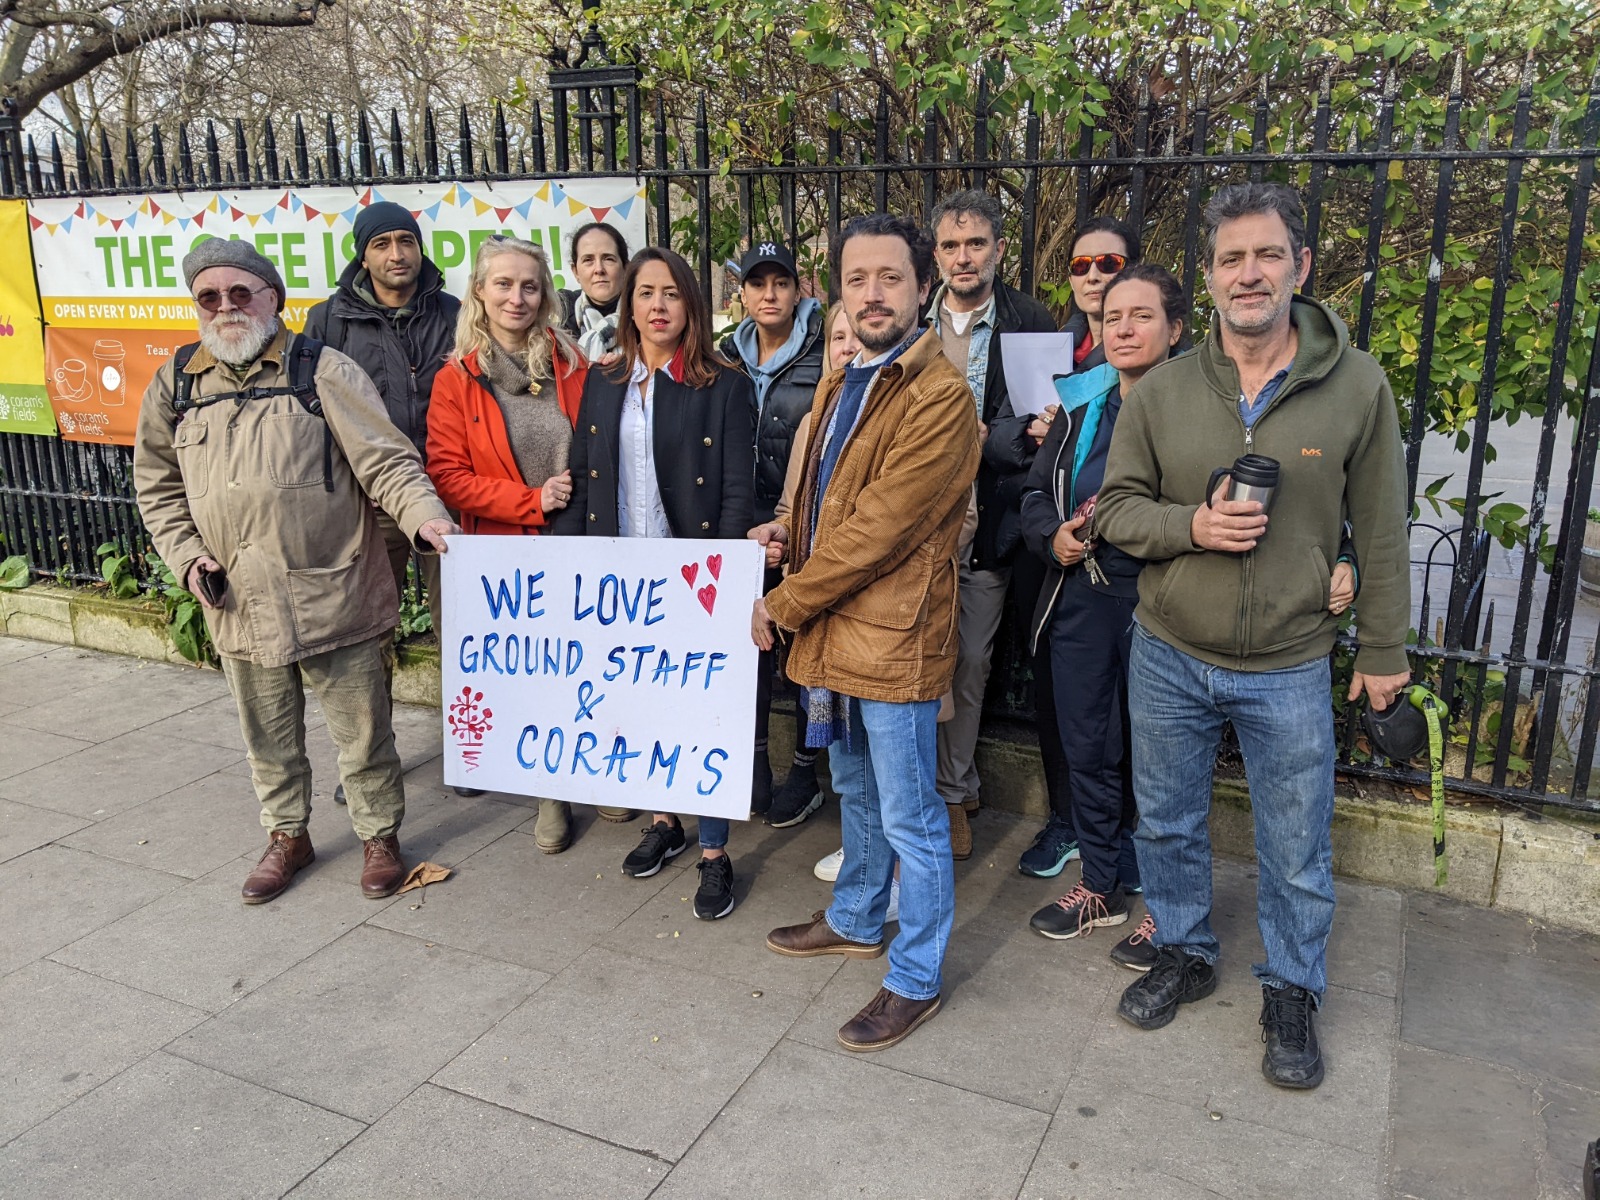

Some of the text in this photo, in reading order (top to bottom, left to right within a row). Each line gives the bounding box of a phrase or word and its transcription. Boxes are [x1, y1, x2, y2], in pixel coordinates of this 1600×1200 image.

[95, 235, 177, 288] THE
[54, 303, 86, 318] OPEN
[88, 304, 125, 319] EVERY
[128, 304, 154, 319] DAY
[159, 305, 200, 320] DURIN
[10, 395, 44, 408] coram's
[12, 407, 37, 421] fields
[73, 411, 110, 425] coram's
[78, 421, 105, 436] fields
[481, 568, 667, 626] WE LOVE
[459, 632, 728, 690] GROUND STAFF
[574, 679, 606, 724] &
[516, 724, 729, 796] CORAM'S
